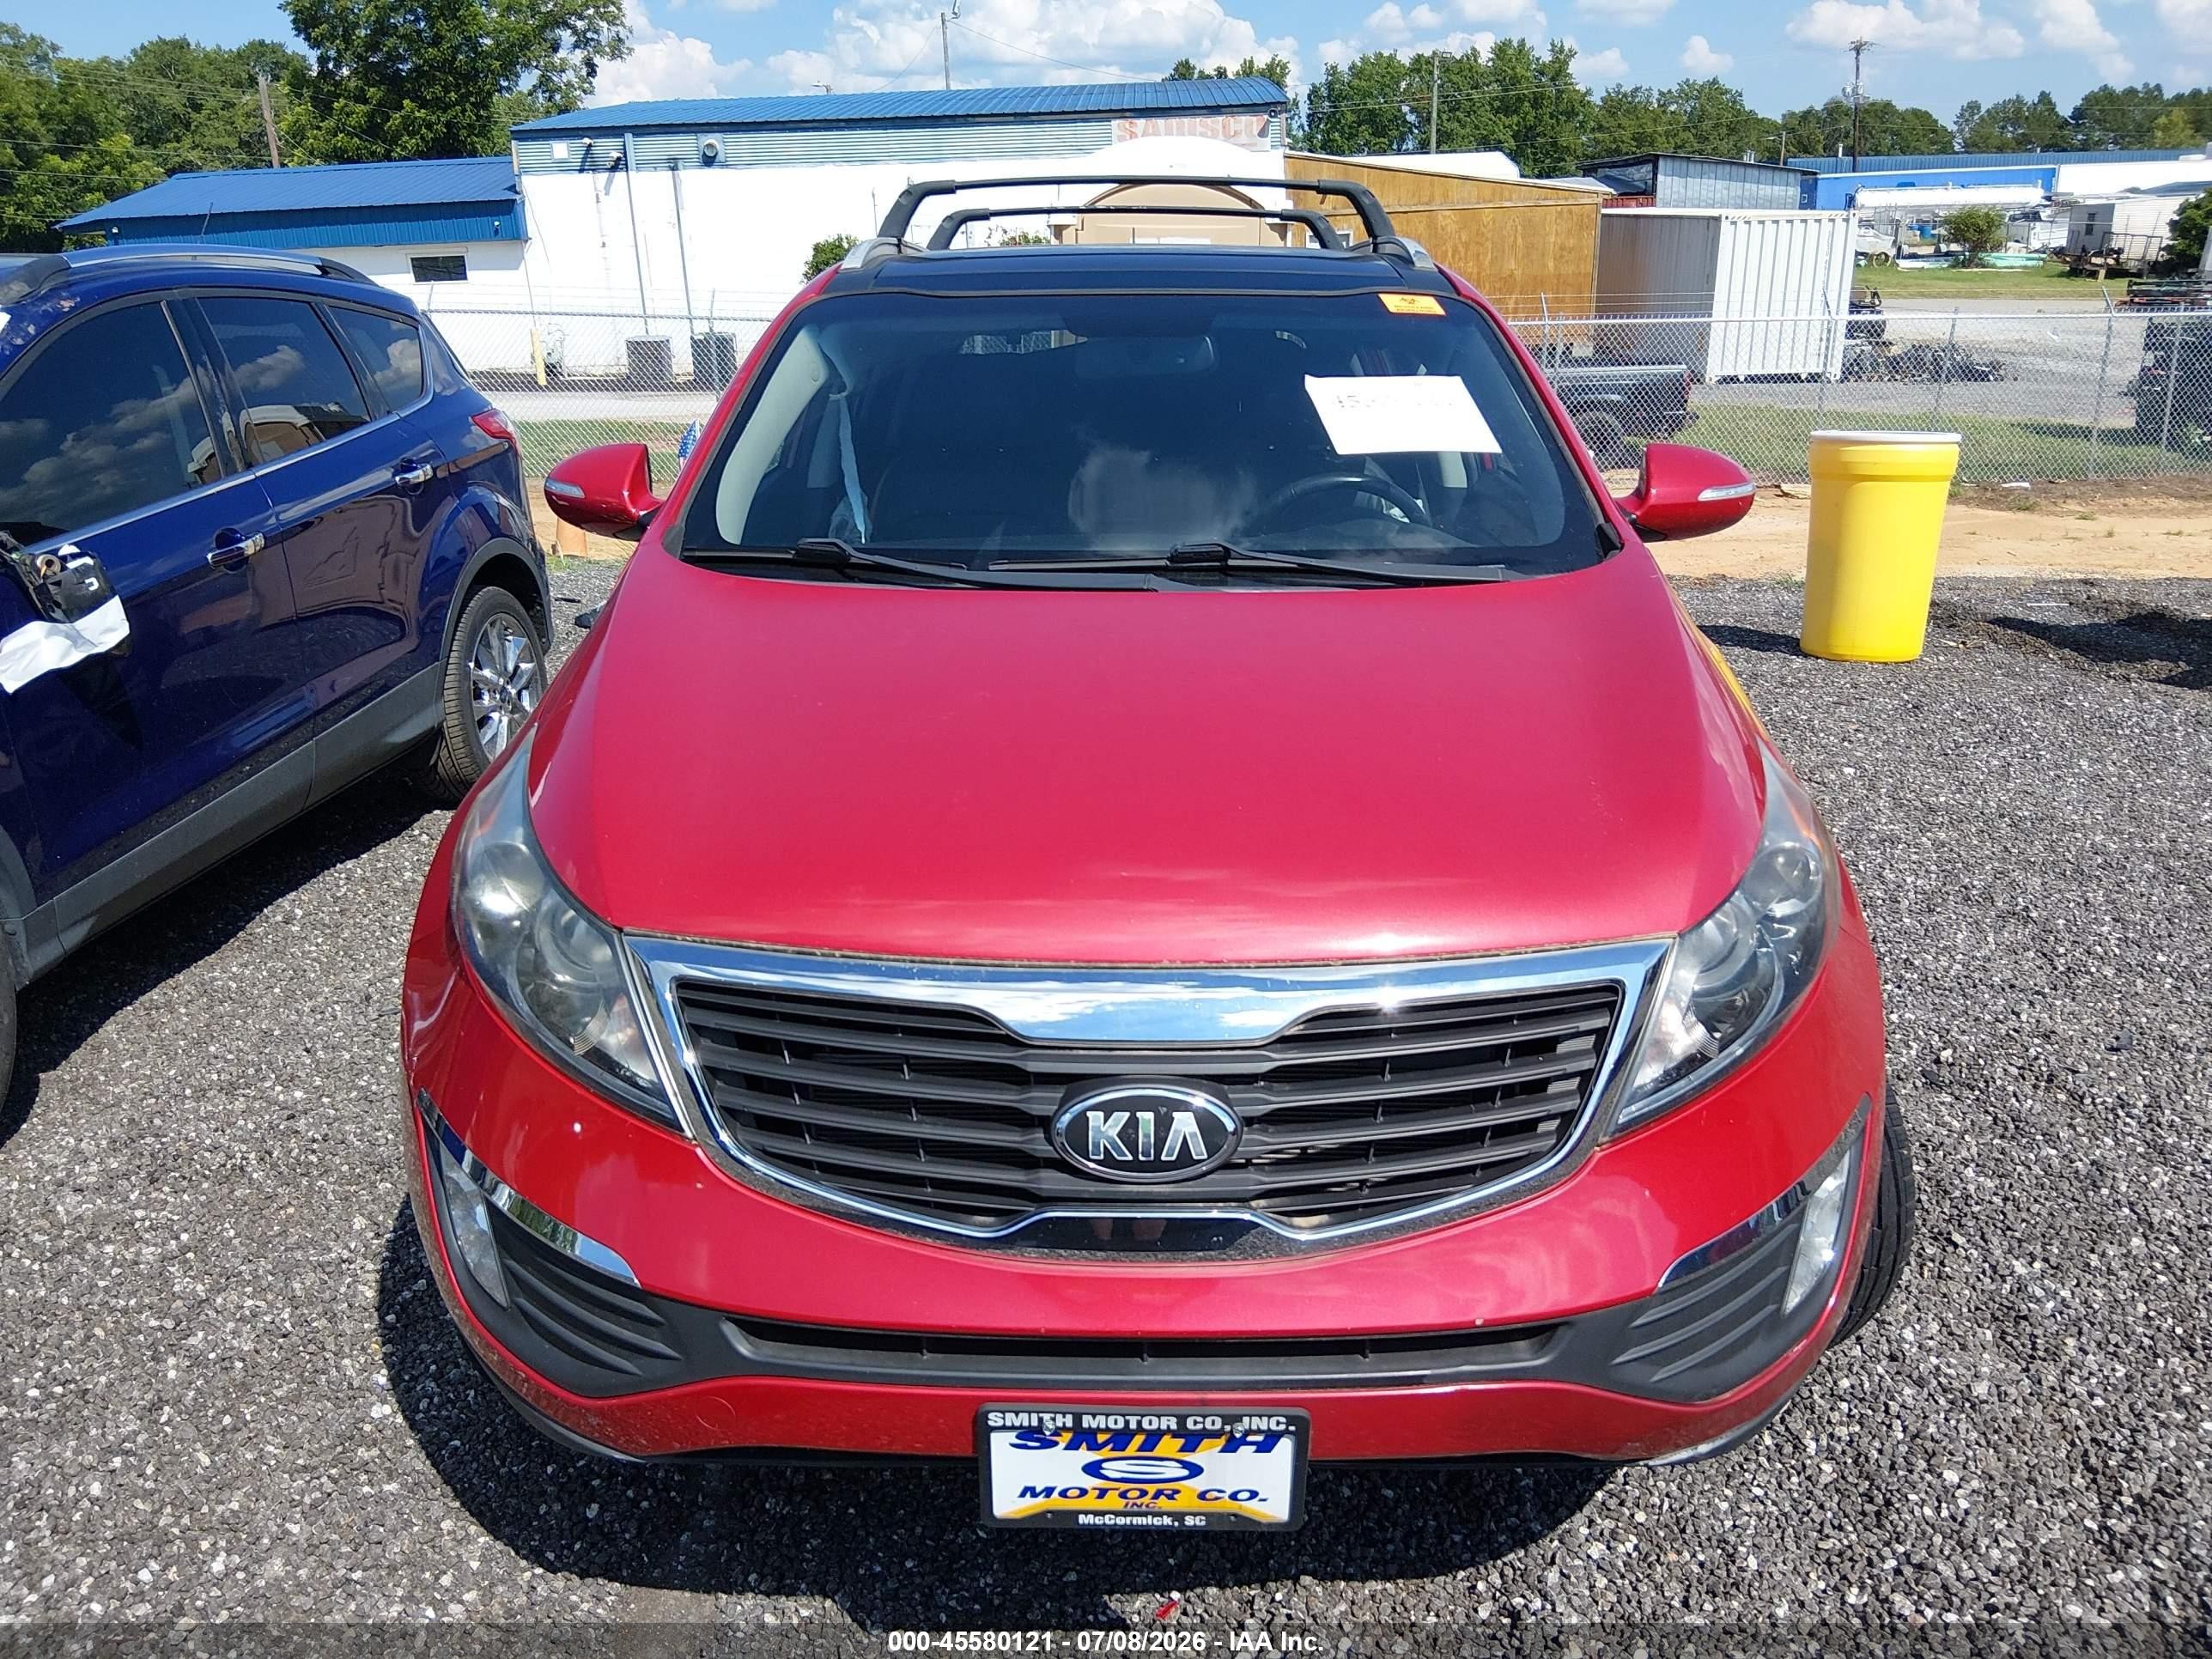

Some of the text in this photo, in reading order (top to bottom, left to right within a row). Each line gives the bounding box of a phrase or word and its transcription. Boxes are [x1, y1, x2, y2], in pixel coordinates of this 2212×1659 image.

[1086, 1111, 1208, 1161] KIA
[988, 1412, 1073, 1428] SMITH
[1082, 1414, 1177, 1430] MOTOR
[1241, 1416, 1296, 1431] INC.
[1008, 1430, 1284, 1453] SMITH
[1018, 1486, 1270, 1502] MOTOR CO.
[1122, 1501, 1163, 1510] INC.
[1079, 1514, 1206, 1527] McCormick, SC
